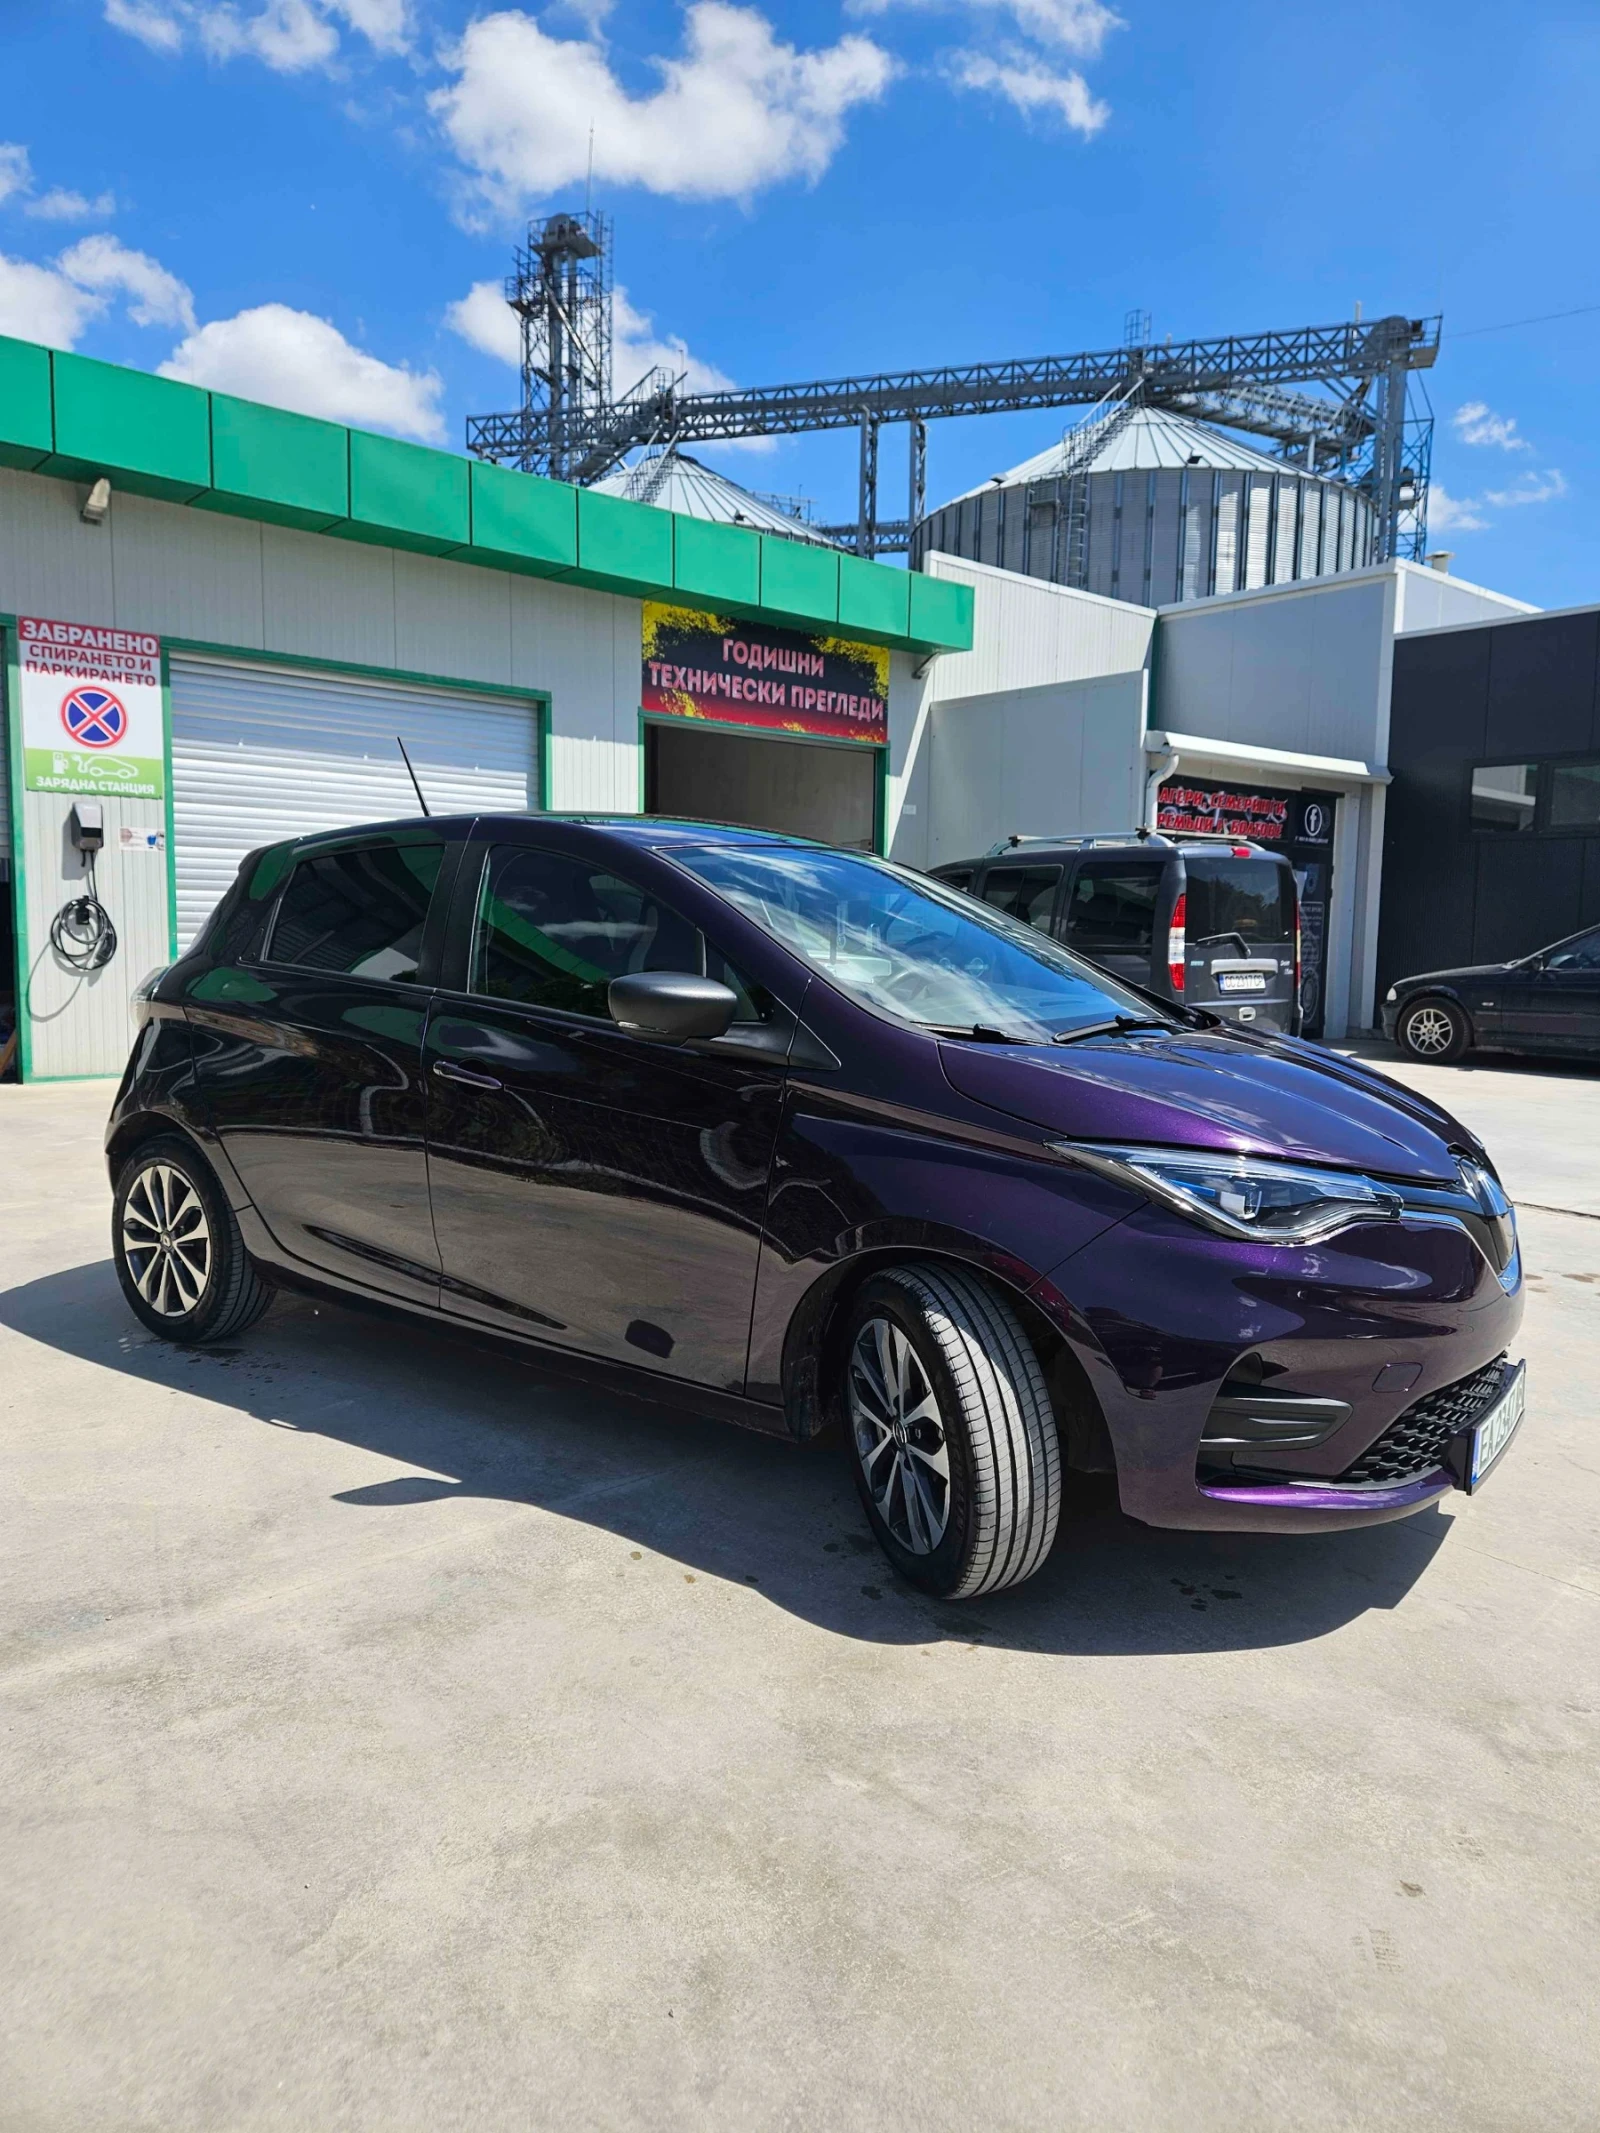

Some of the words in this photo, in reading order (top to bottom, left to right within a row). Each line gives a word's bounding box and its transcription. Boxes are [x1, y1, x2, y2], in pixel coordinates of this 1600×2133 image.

[22, 620, 157, 655] ЗАБРАНЕНО
[29, 644, 136, 669] СПИРАНЕТО
[140, 658, 151, 671] И
[723, 638, 824, 677] ГОДИШНИ
[26, 660, 156, 686] ПАРКИРАНЕТО
[648, 661, 785, 706] ТЕХНИЧЕСКИ
[790, 685, 884, 722] ПРЕГЛЕДИ
[36, 775, 97, 791] ЗАРЯДНА
[99, 780, 155, 795] СТАНЦИЯ
[1158, 787, 1207, 810] АГЕРИ,
